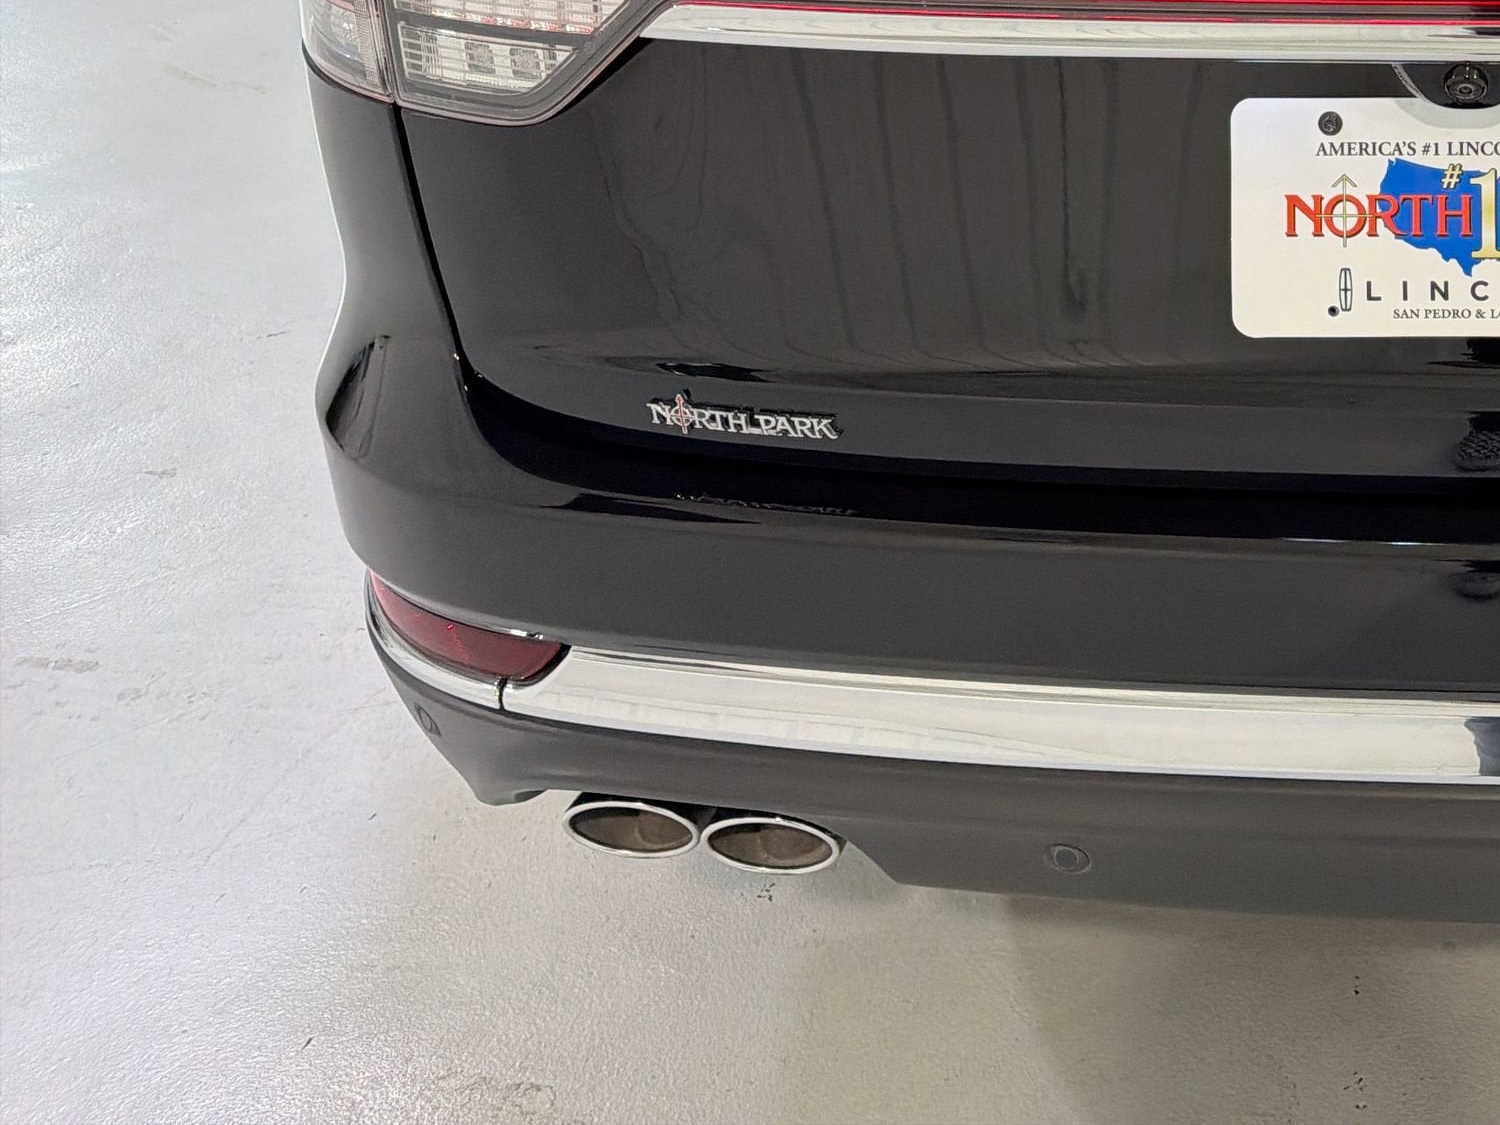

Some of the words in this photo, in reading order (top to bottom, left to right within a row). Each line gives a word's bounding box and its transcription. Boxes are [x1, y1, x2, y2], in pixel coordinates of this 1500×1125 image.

[1315, 141, 1416, 156] AMERICA'S
[1421, 141, 1440, 156] #1
[1284, 194, 1474, 238] NORTH
[1392, 308, 1421, 319] SAN
[1424, 308, 1471, 319] PEDRO
[1475, 308, 1487, 319] &
[646, 402, 749, 434] NORTH
[752, 413, 840, 440] PARK
